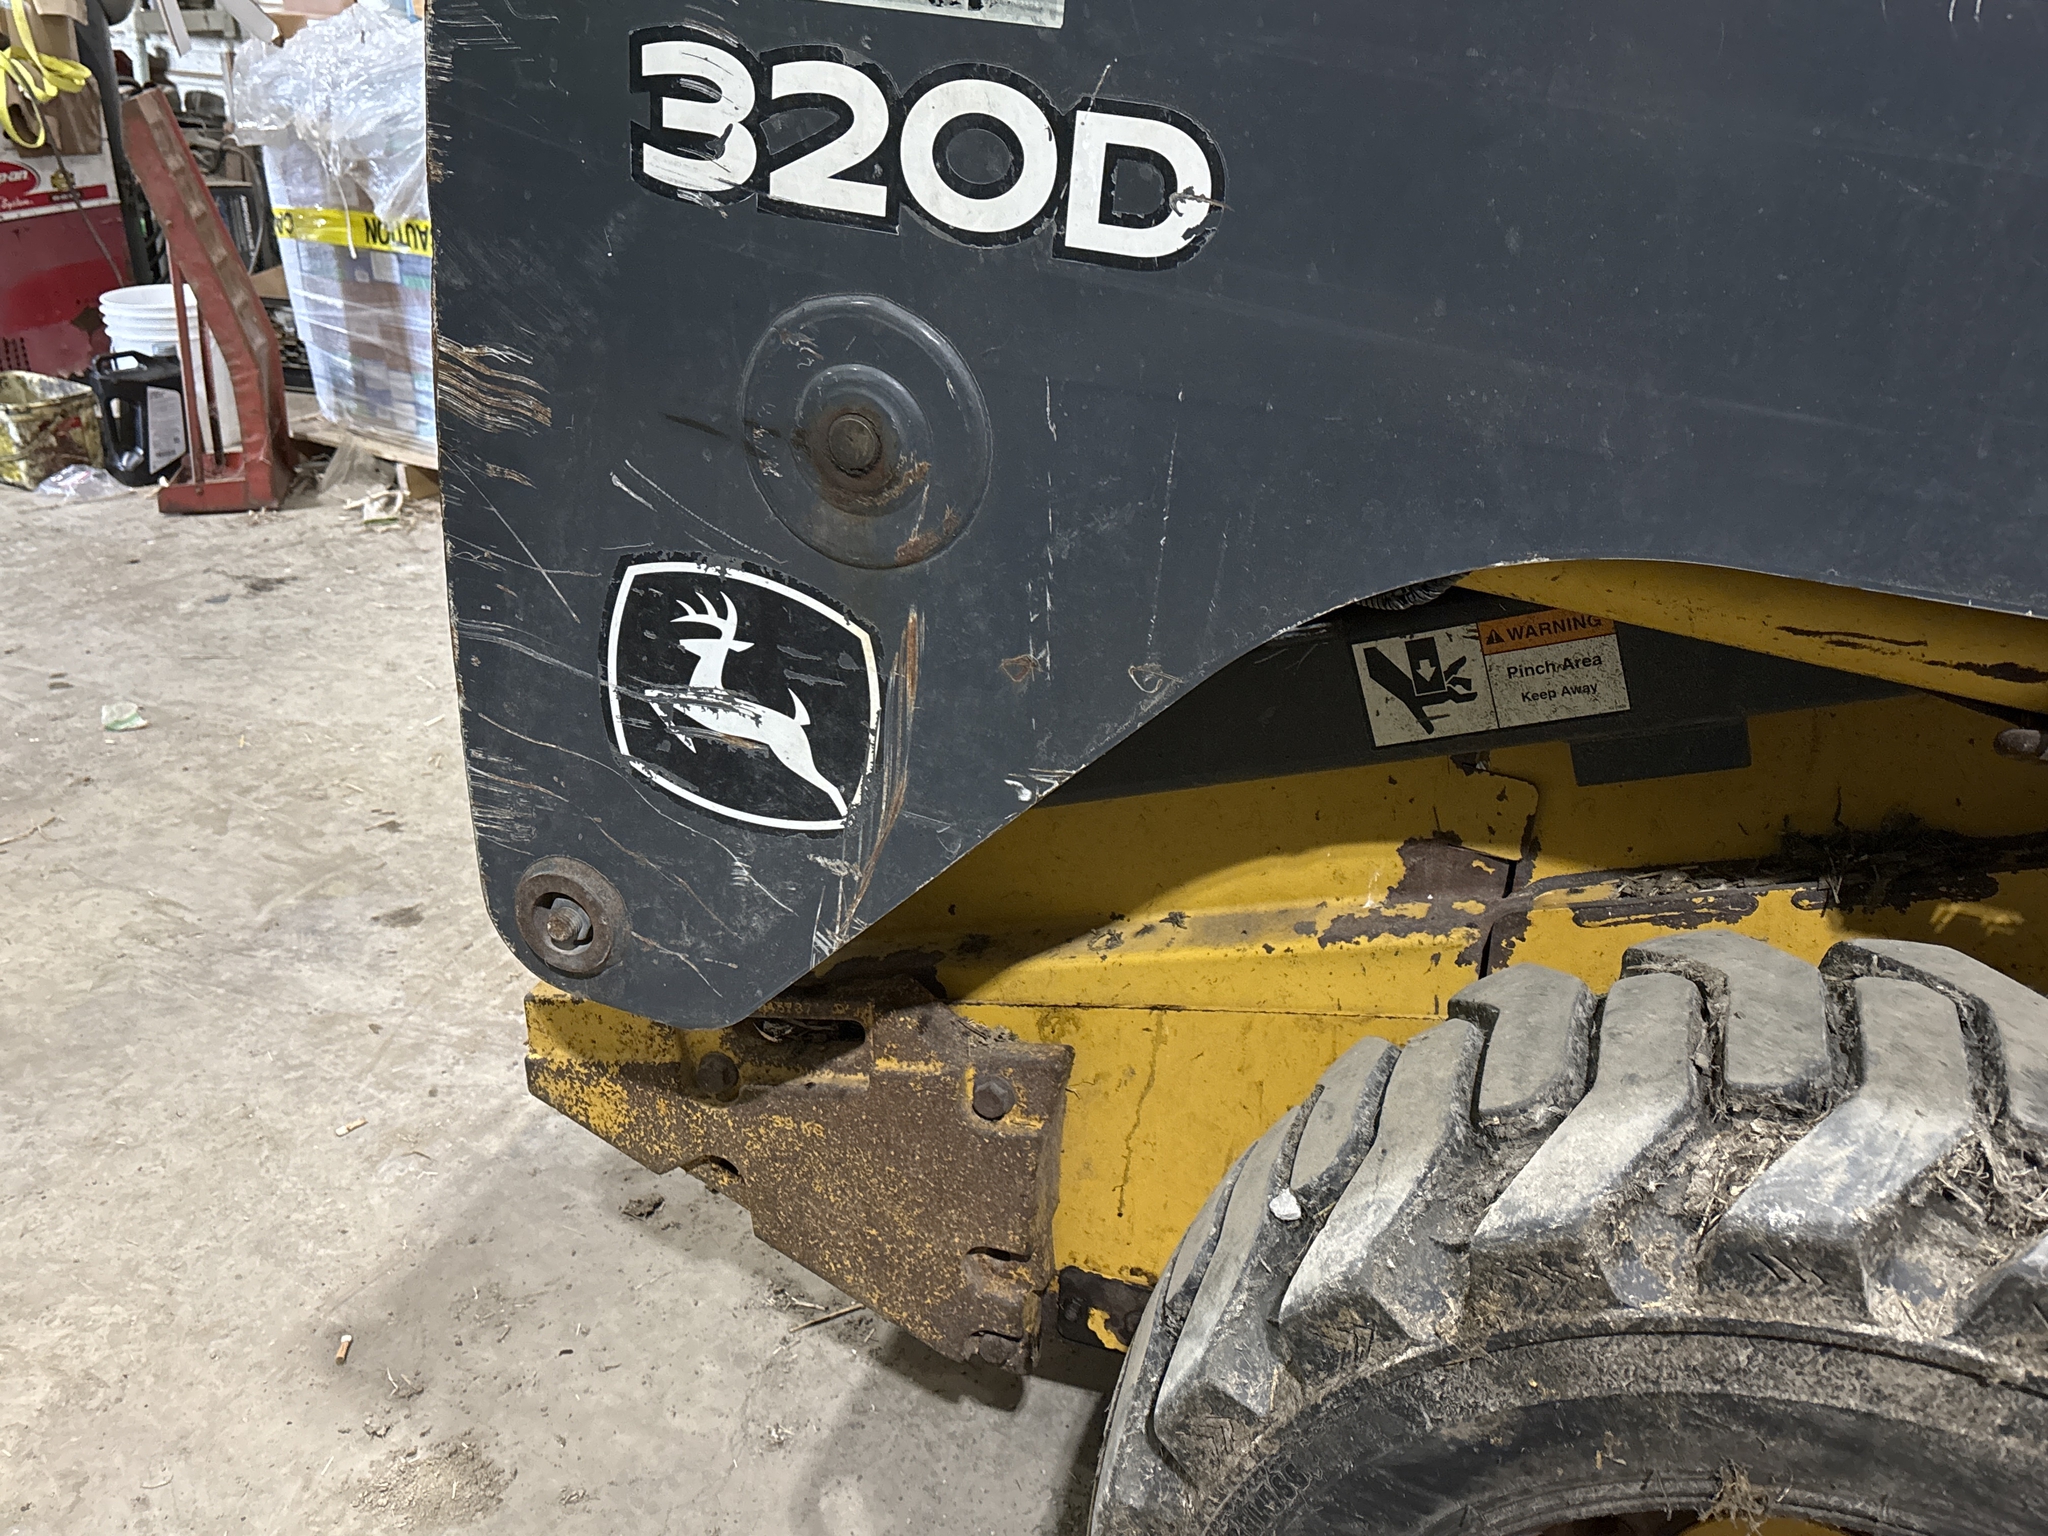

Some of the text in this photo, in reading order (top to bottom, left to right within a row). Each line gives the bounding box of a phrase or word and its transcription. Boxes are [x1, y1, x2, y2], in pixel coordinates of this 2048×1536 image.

[641, 40, 1213, 258] 320D
[1506, 615, 1603, 641] WARNING
[1506, 655, 1603, 680] Pinch Area
[1521, 683, 1598, 703] Keep Away
